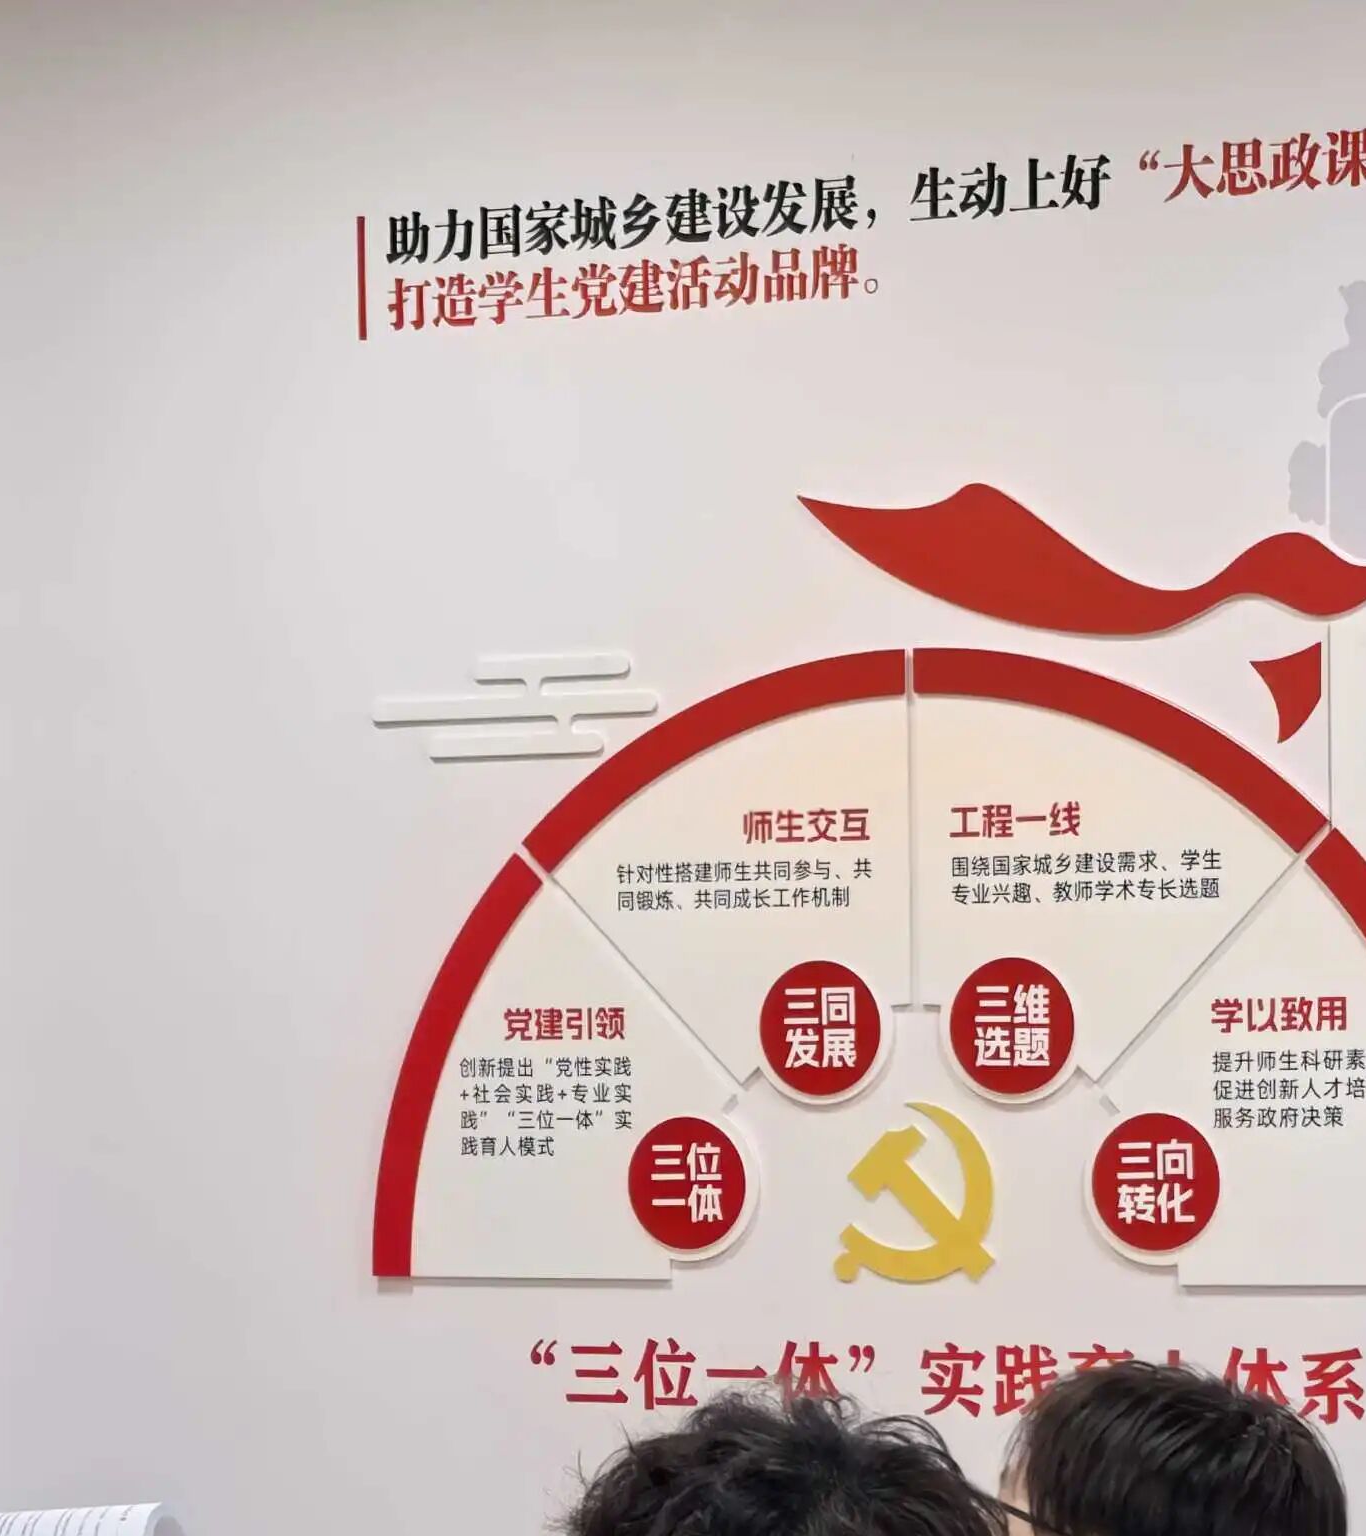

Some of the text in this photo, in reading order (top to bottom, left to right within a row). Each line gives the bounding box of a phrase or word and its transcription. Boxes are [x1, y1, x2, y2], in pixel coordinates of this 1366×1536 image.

[387, 243, 880, 332] 打造学生党建活动品牌。
[742, 808, 871, 844] 师生交互
[949, 801, 1081, 838] 工程一线
[616, 858, 872, 885] 针对性搭建师生共同参与、共
[951, 849, 1222, 877] 围绕国家城乡建设需求、学生
[617, 886, 850, 912] 同锻炼、共同成长工作机制
[951, 877, 1220, 905] 专业兴趣、教师学术专长选题
[783, 987, 855, 1026] 三同
[975, 984, 1050, 1025] 三维
[1211, 996, 1347, 1033] 学以致用
[504, 1007, 625, 1041] 党建引领
[785, 1028, 856, 1069] 发展
[974, 1027, 1050, 1068] 选题
[1213, 1107, 1344, 1128] 服务政府决策
[460, 1136, 554, 1158] 践育人模式
[650, 1142, 722, 1182] 三位
[1117, 1139, 1194, 1180] 三向
[651, 1184, 723, 1223] 一体
[1117, 1183, 1195, 1224] 转化
[530, 1337, 1366, 1424] “三位一体”实践体系
